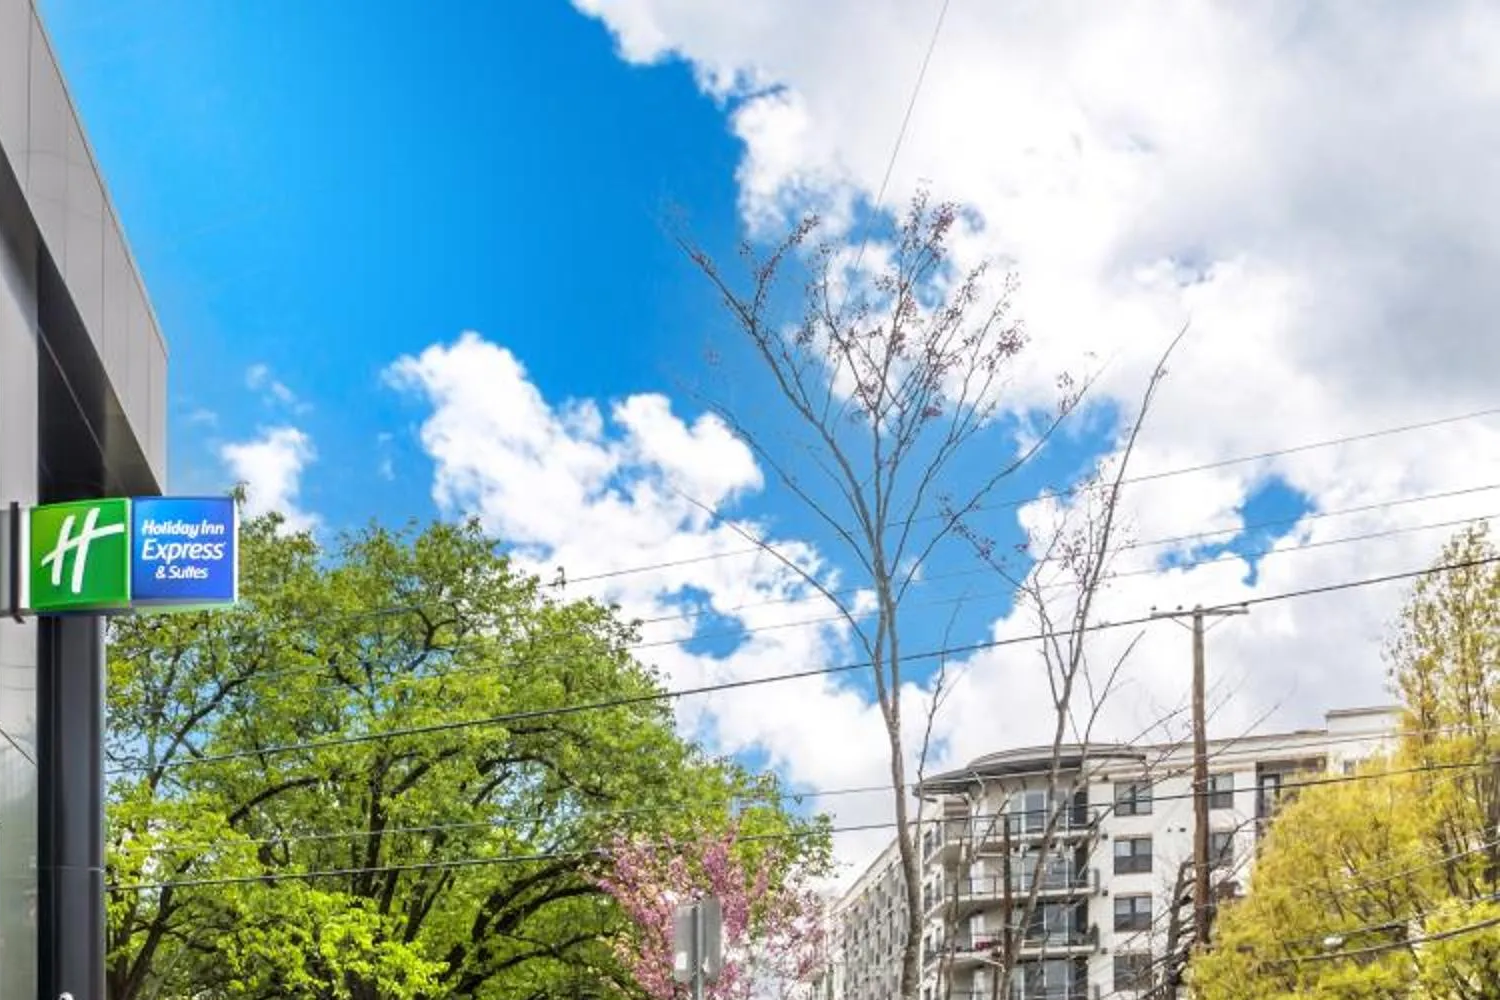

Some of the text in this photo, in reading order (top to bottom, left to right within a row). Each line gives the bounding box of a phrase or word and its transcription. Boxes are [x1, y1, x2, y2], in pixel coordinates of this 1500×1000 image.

[141, 518, 225, 539] Holiday Inn
[41, 507, 125, 593] H
[141, 538, 225, 565] Express
[155, 565, 209, 579] & Suites
